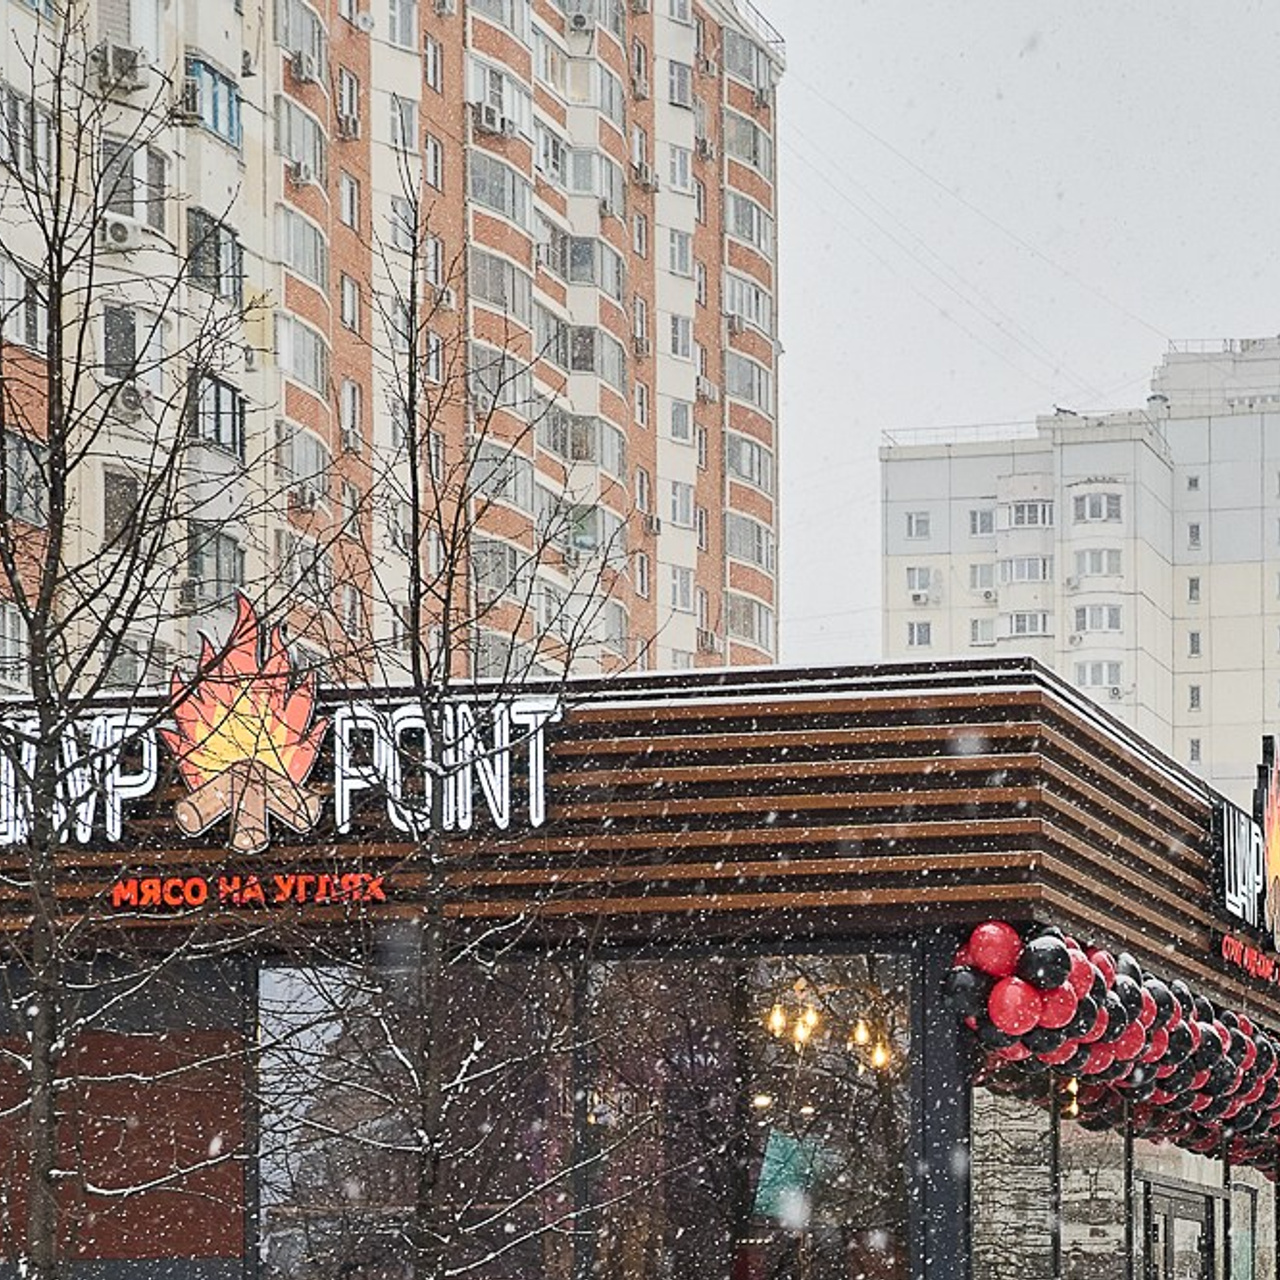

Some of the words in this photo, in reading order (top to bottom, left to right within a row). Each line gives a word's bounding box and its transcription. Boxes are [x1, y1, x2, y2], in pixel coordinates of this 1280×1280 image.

[334, 700, 562, 834] POINT
[112, 877, 208, 907] МЯСО
[218, 874, 266, 904] НА
[273, 872, 386, 903] УГЛЯХ
